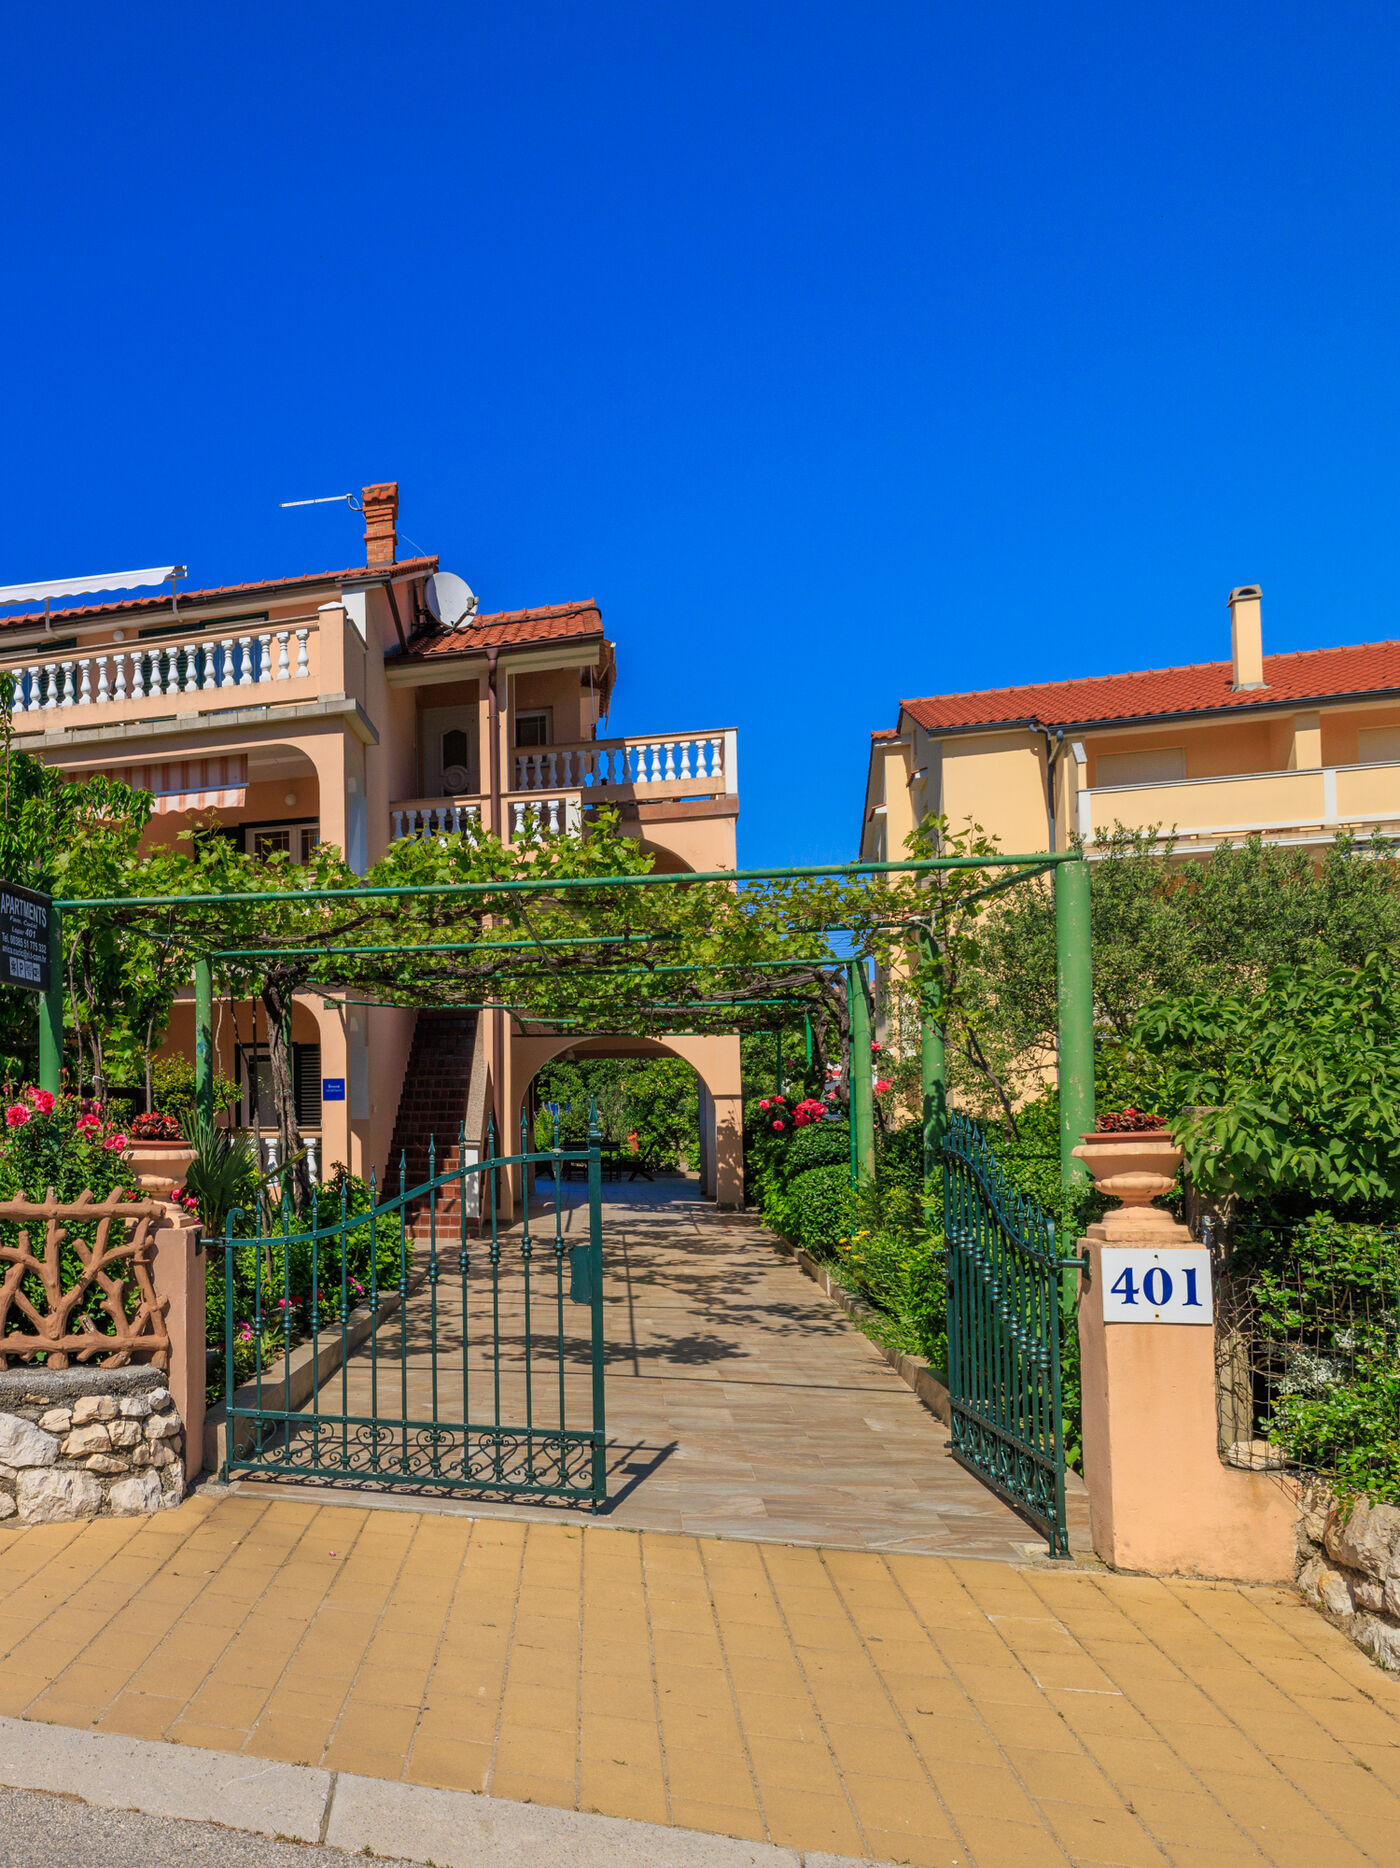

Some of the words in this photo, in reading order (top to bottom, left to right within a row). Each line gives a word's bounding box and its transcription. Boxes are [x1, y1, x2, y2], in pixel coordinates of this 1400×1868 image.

[0, 892, 47, 928] APARTMENTS
[10, 935, 24, 948] 00385
[24, 938, 30, 949] 51
[25, 928, 36, 938] 401
[1110, 1267, 1203, 1307] 401
